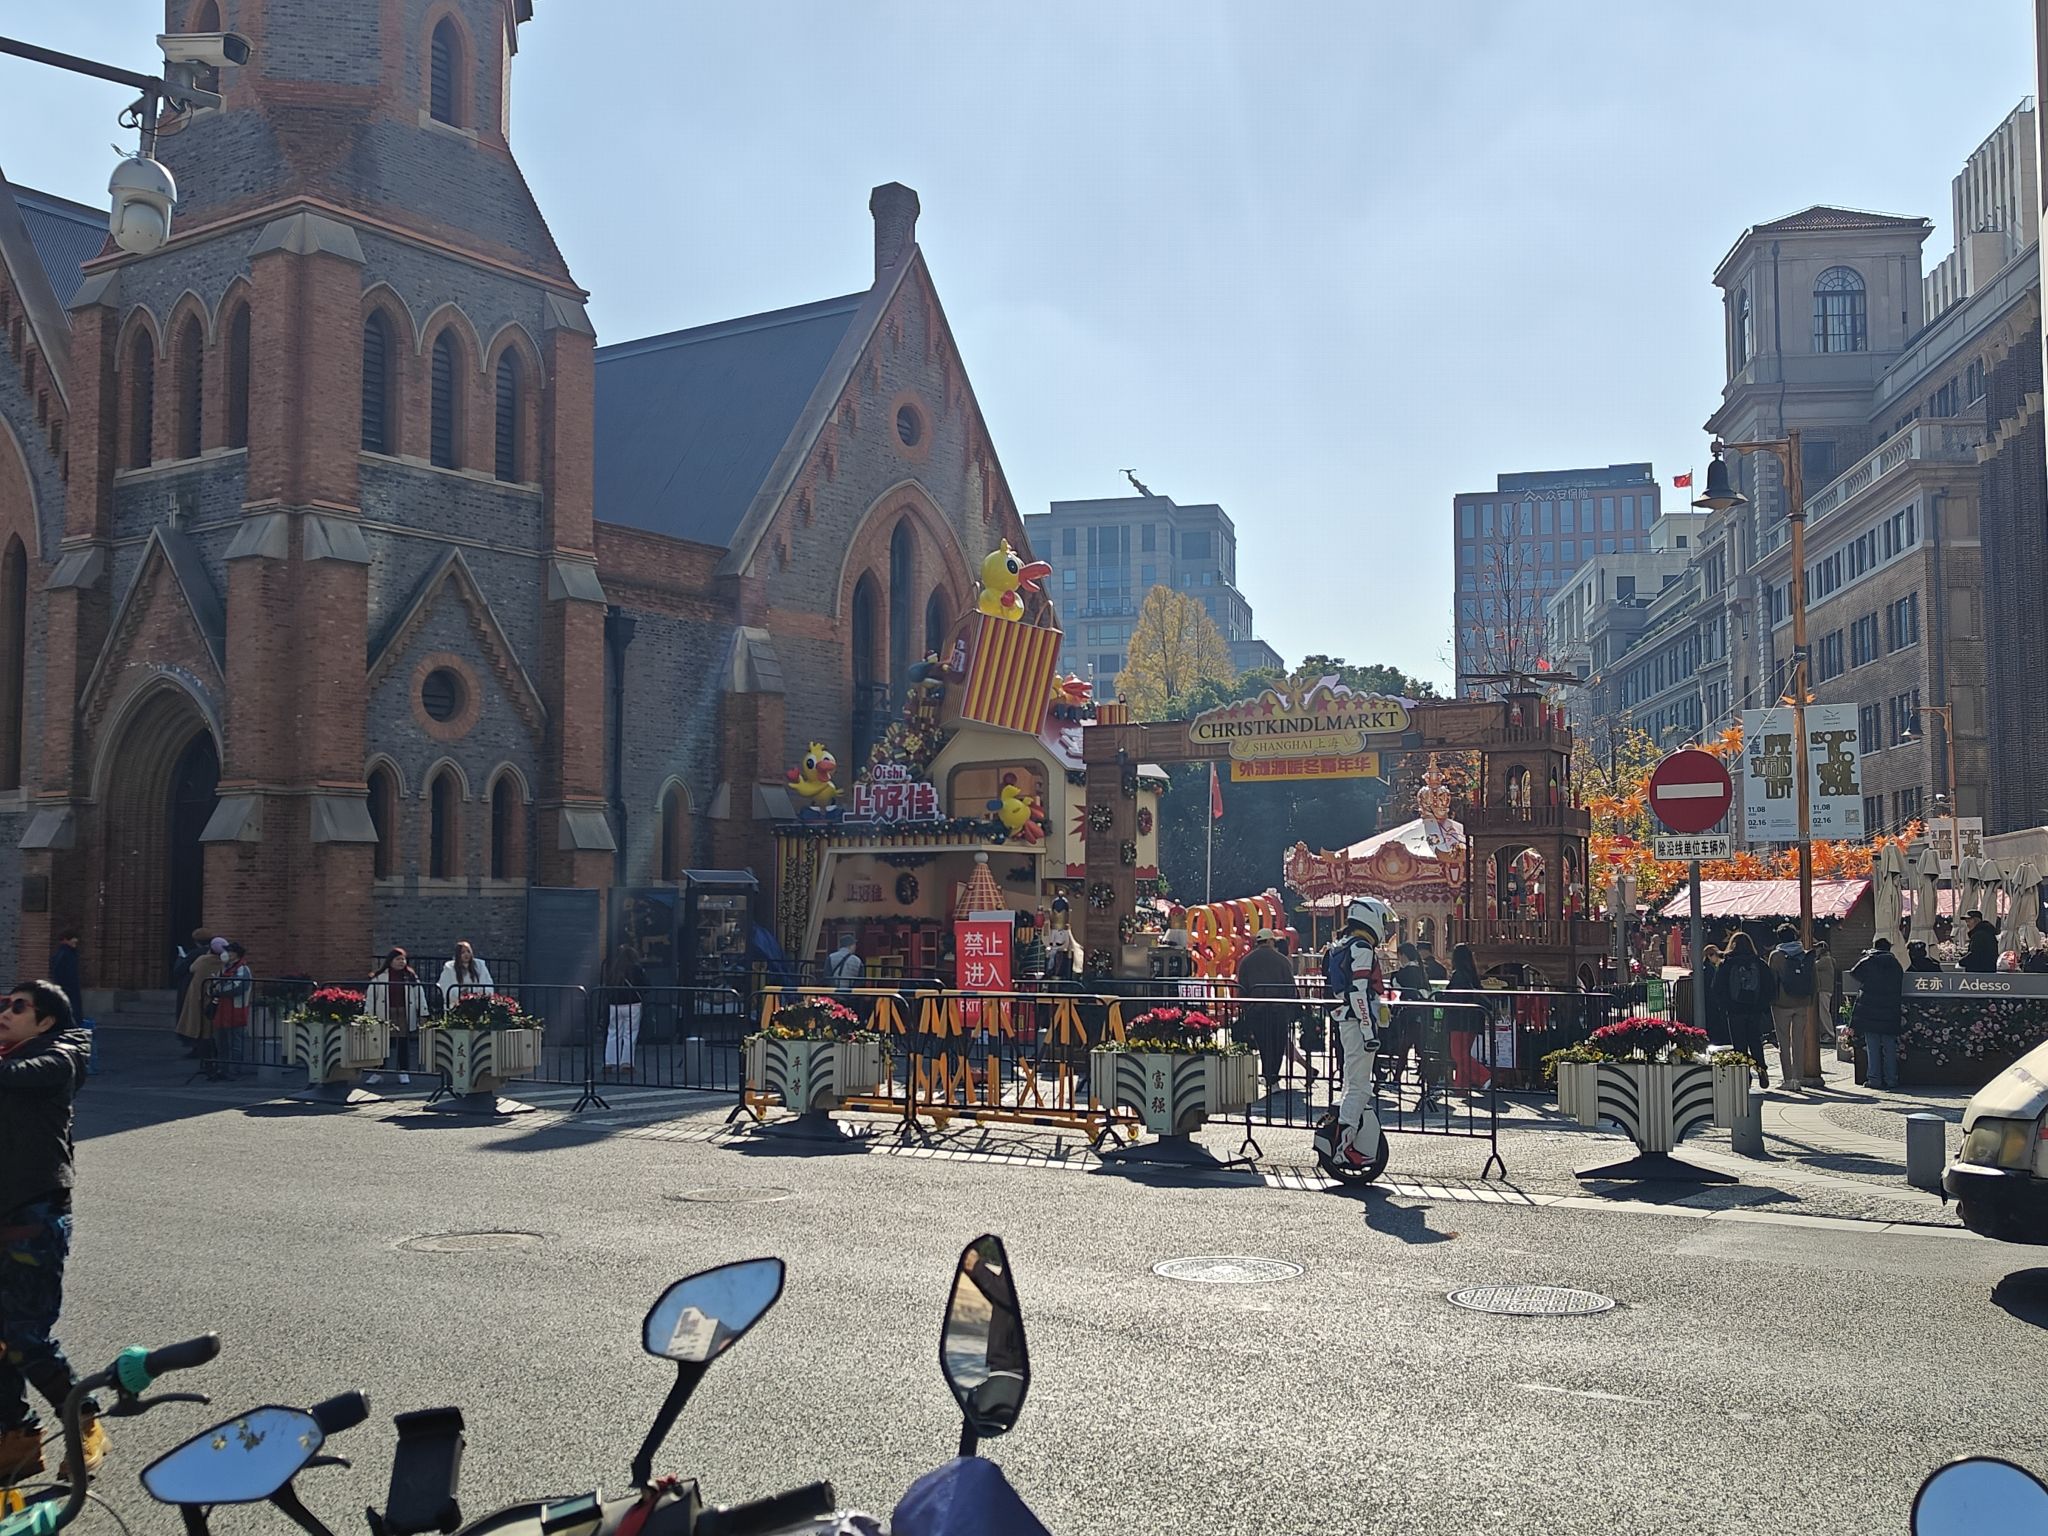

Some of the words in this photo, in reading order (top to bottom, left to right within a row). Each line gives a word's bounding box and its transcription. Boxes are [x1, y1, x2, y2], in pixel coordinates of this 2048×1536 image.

[1199, 711, 1399, 739] CHRISTKINDLMARKT
[1252, 739, 1312, 752] SHANGHAI
[1315, 736, 1340, 749] 上海
[873, 765, 904, 780] Oishi
[843, 783, 938, 824] 上好佳
[1813, 803, 1831, 811] 11.08
[1657, 839, 1727, 857] 除沿线单位车辆外
[964, 931, 1004, 957] 禁止
[964, 962, 1004, 987] 进入
[1914, 976, 1943, 991] 在亦
[1958, 978, 2011, 991] Adesso
[960, 1001, 980, 1012] EXIT
[1151, 1069, 1166, 1114] 富强
